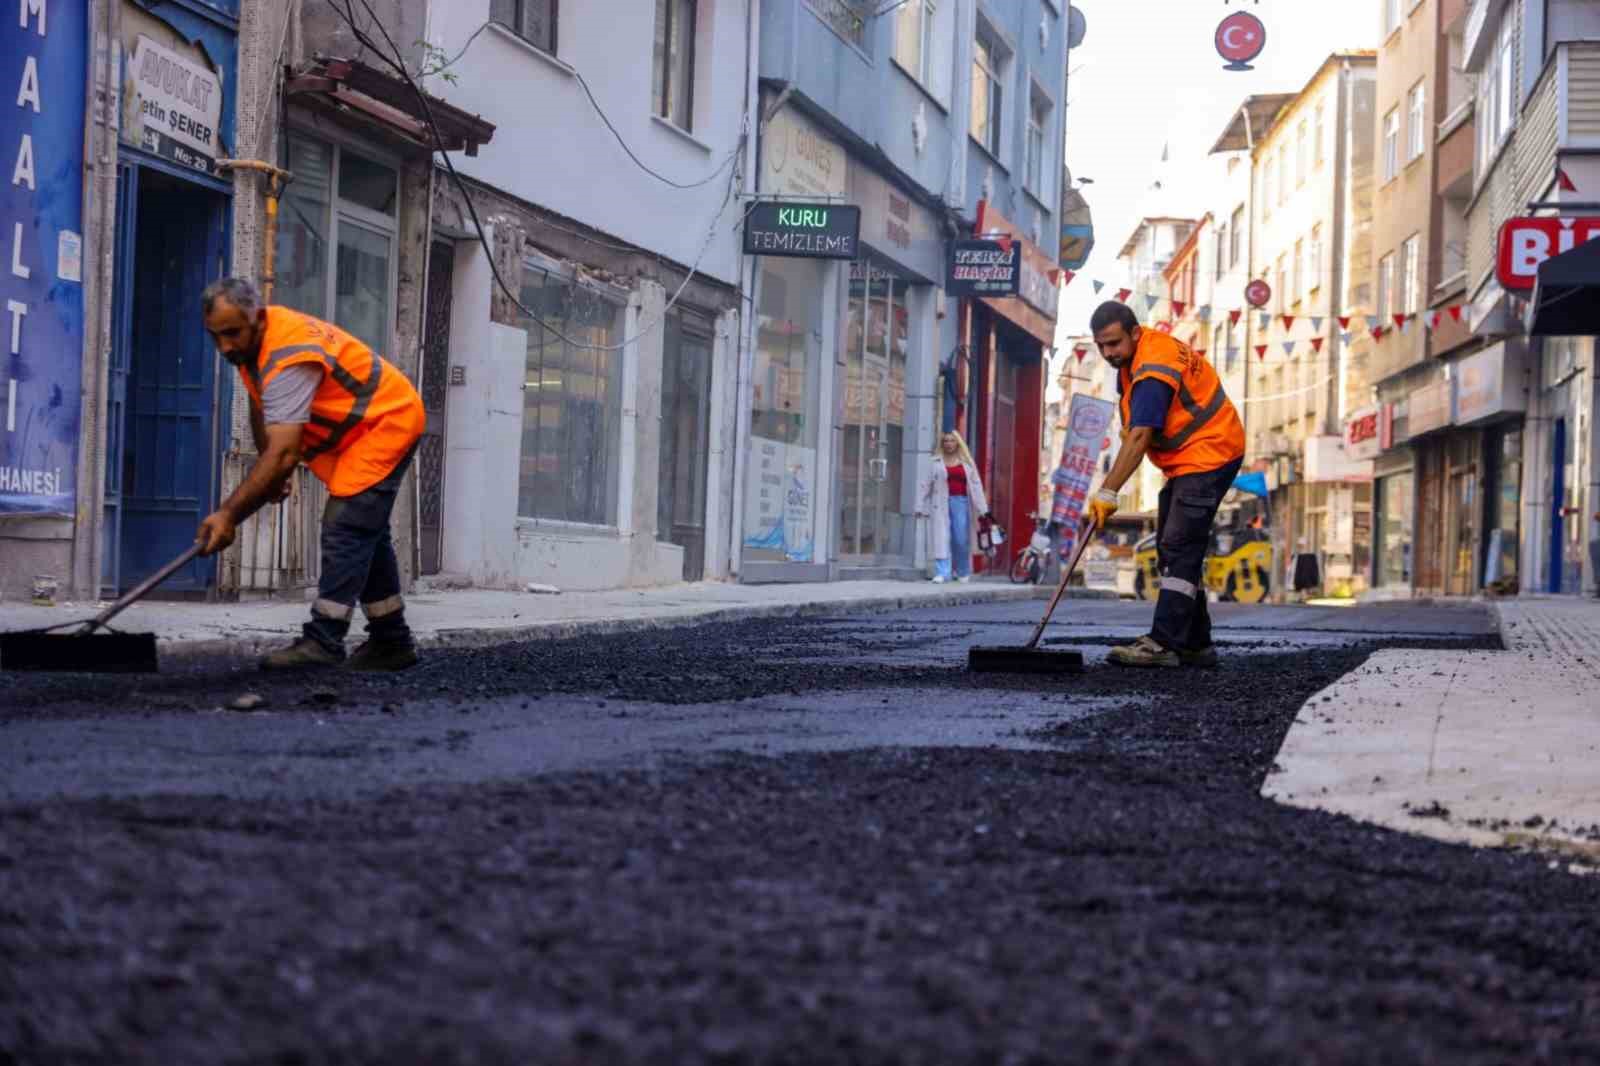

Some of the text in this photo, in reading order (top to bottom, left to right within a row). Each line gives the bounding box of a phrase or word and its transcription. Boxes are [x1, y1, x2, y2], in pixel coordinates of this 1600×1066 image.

[140, 95, 165, 121] etin
[168, 110, 211, 145] ŞENER
[778, 207, 827, 228] KURU
[1511, 217, 1600, 276] Bİ
